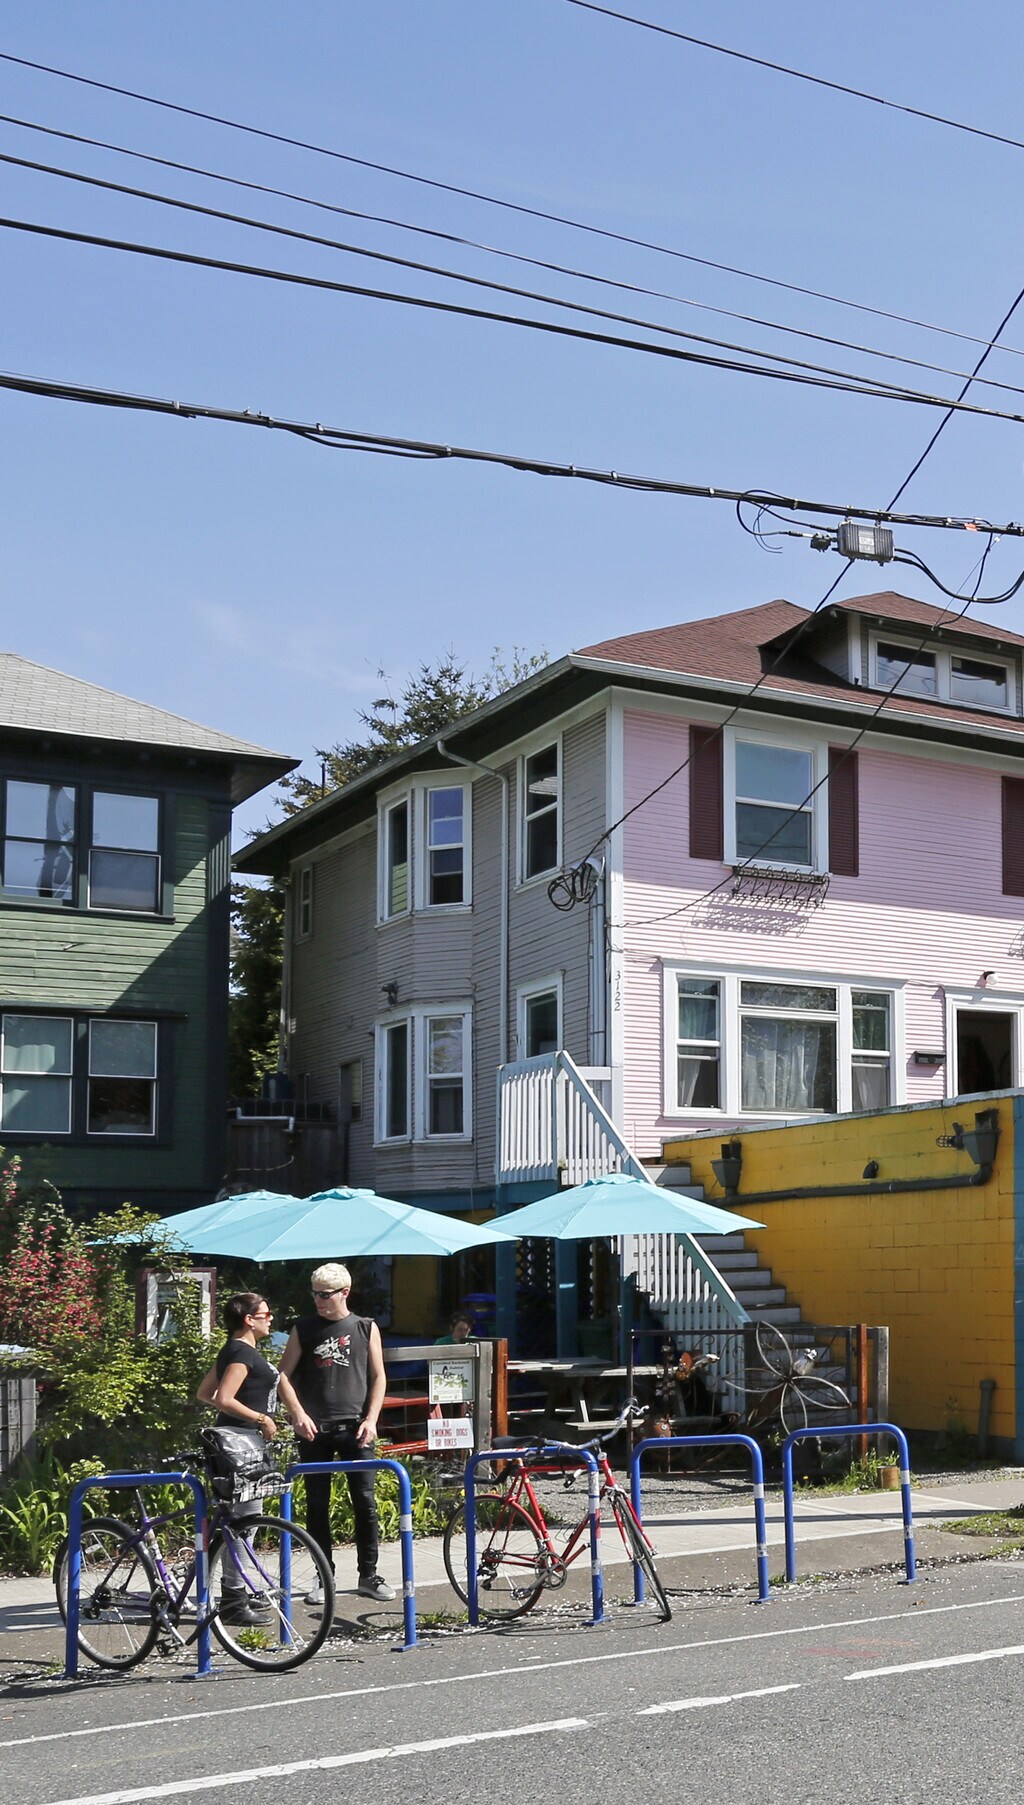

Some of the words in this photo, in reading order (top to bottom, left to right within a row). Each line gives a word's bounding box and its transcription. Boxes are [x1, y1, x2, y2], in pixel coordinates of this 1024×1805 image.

[431, 1428, 452, 1437] SMOKING
[456, 1428, 468, 1437] DOGS
[444, 1439, 457, 1447] BIKES
